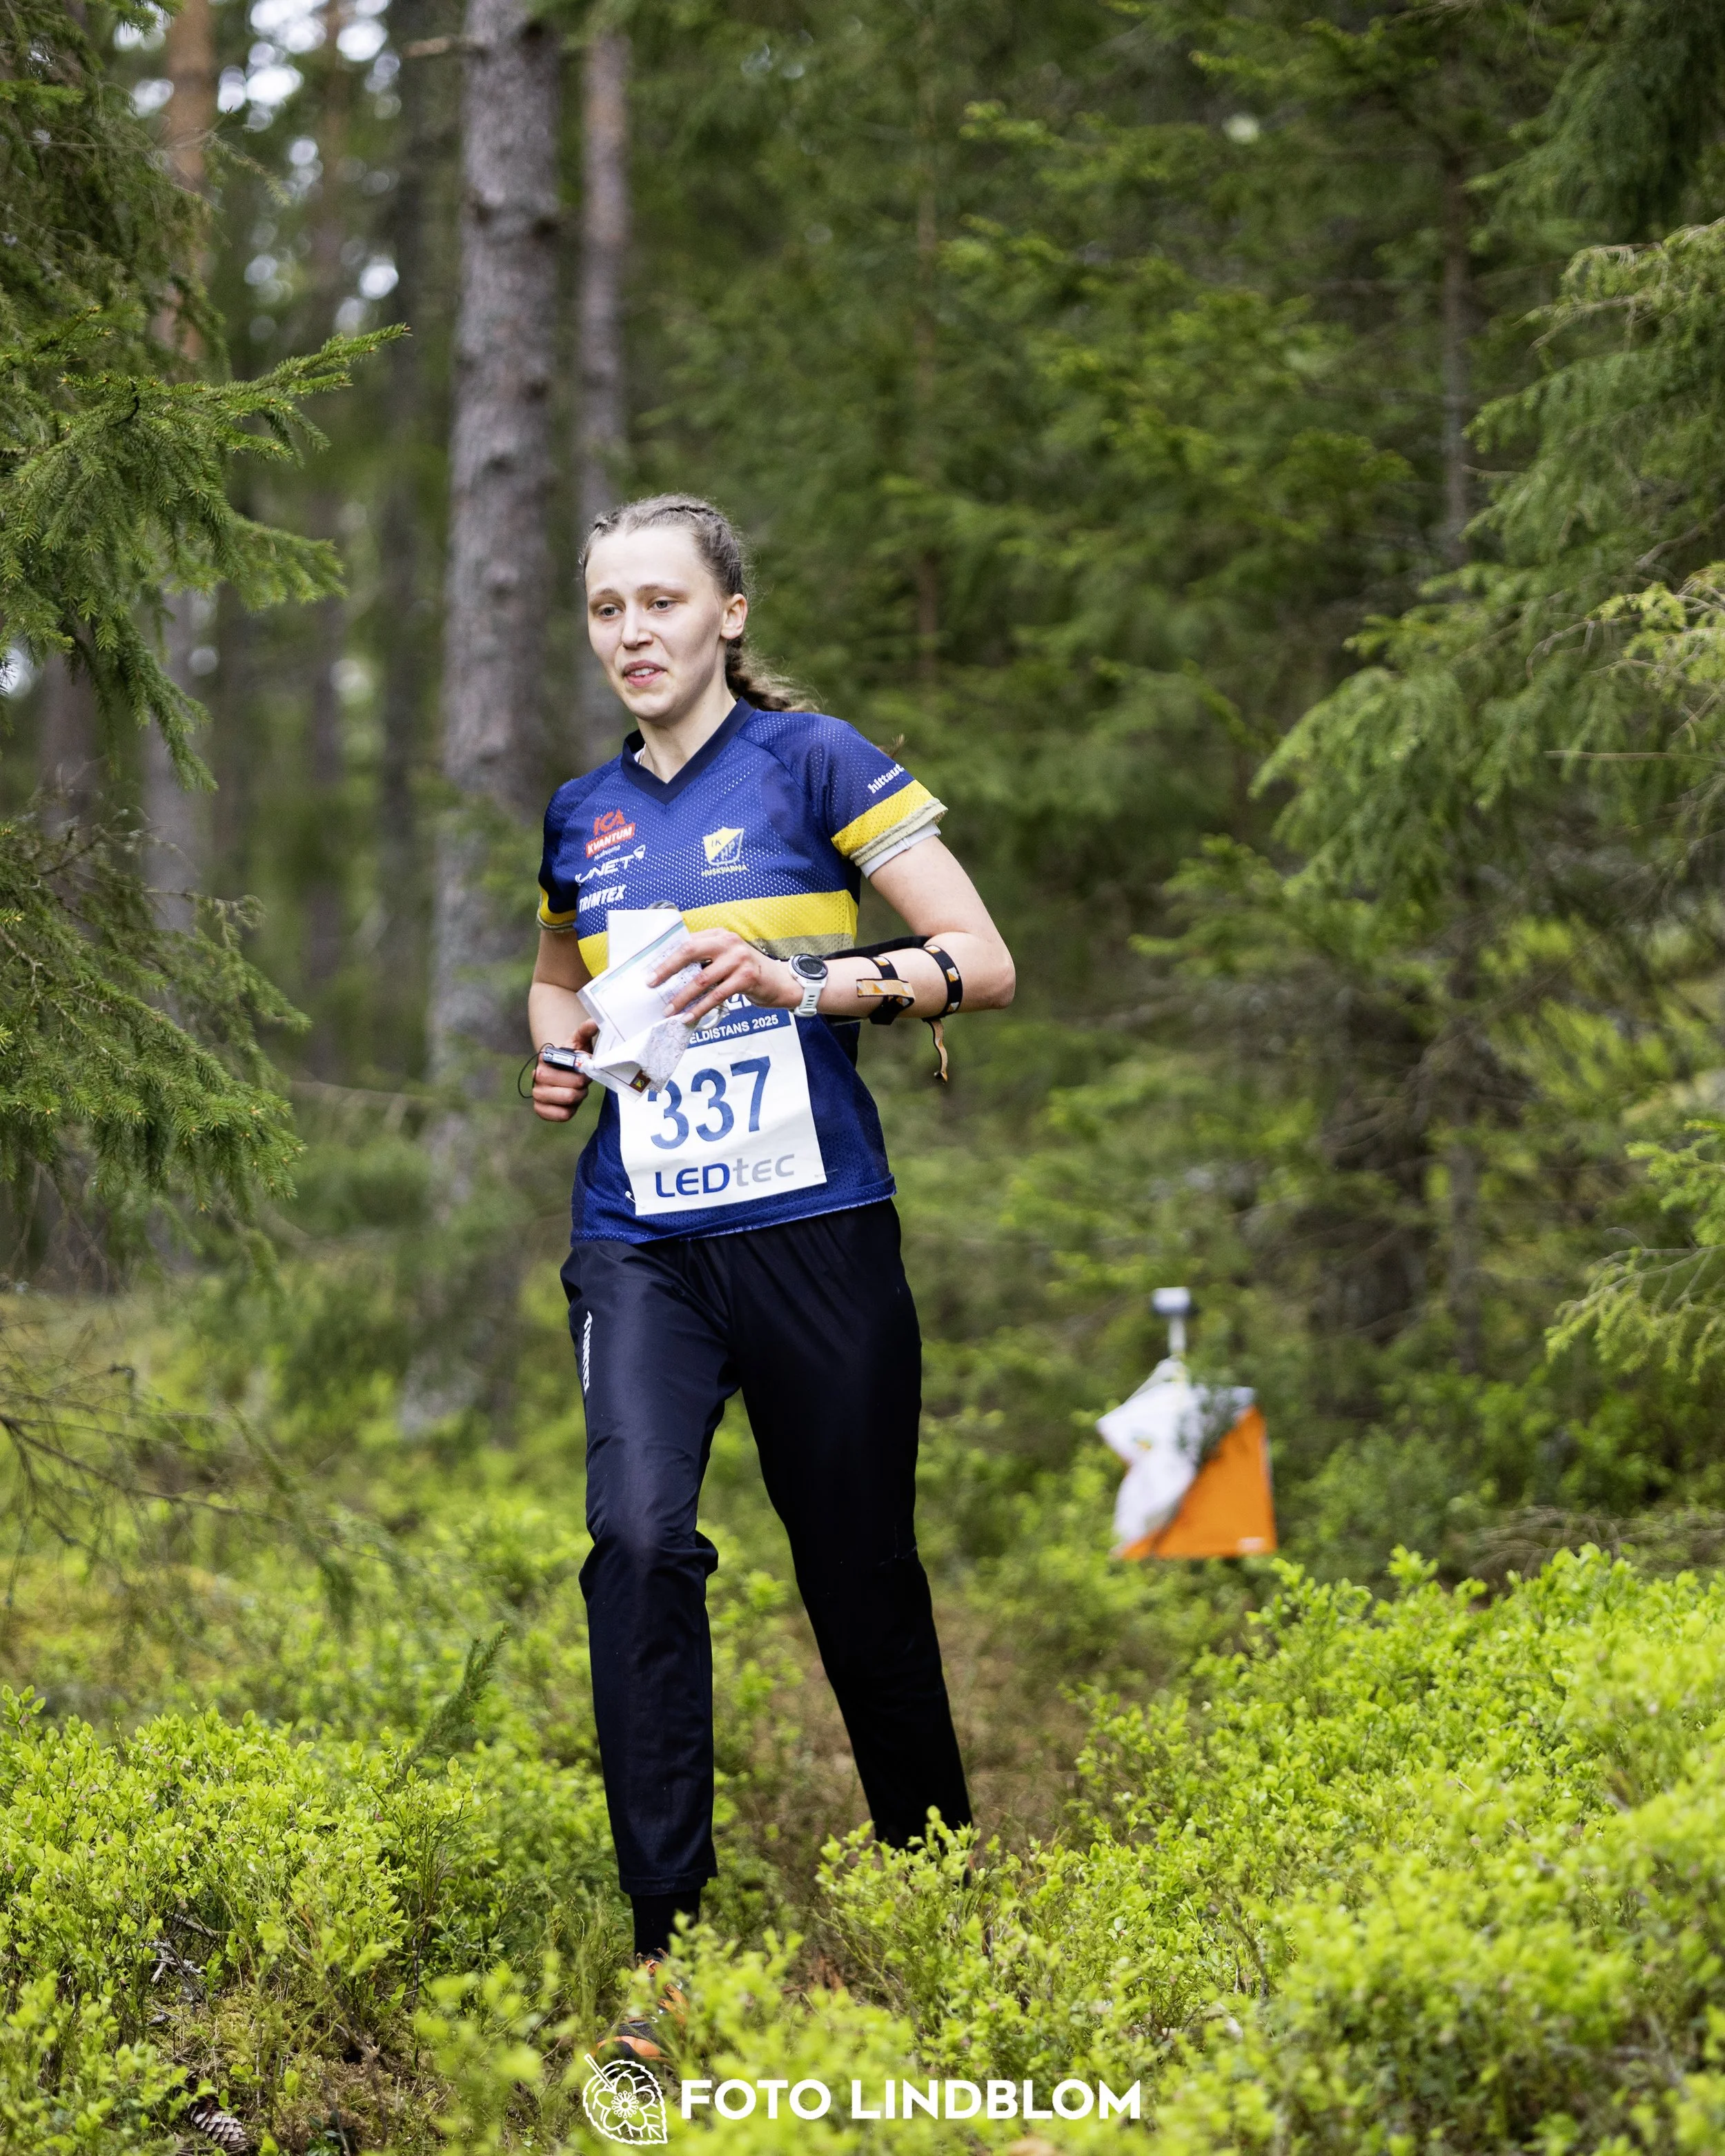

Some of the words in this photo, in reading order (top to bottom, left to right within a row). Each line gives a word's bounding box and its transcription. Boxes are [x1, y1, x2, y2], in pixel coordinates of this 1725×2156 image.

[593, 809, 625, 836] ICA
[586, 826, 633, 856] KVANTUM
[700, 864, 750, 878] HUSKVARNA
[579, 883, 627, 913] TRIMTEX
[689, 1020, 750, 1045] ELDISTANS
[751, 1014, 779, 1030] 2025
[647, 1056, 771, 1149] 337
